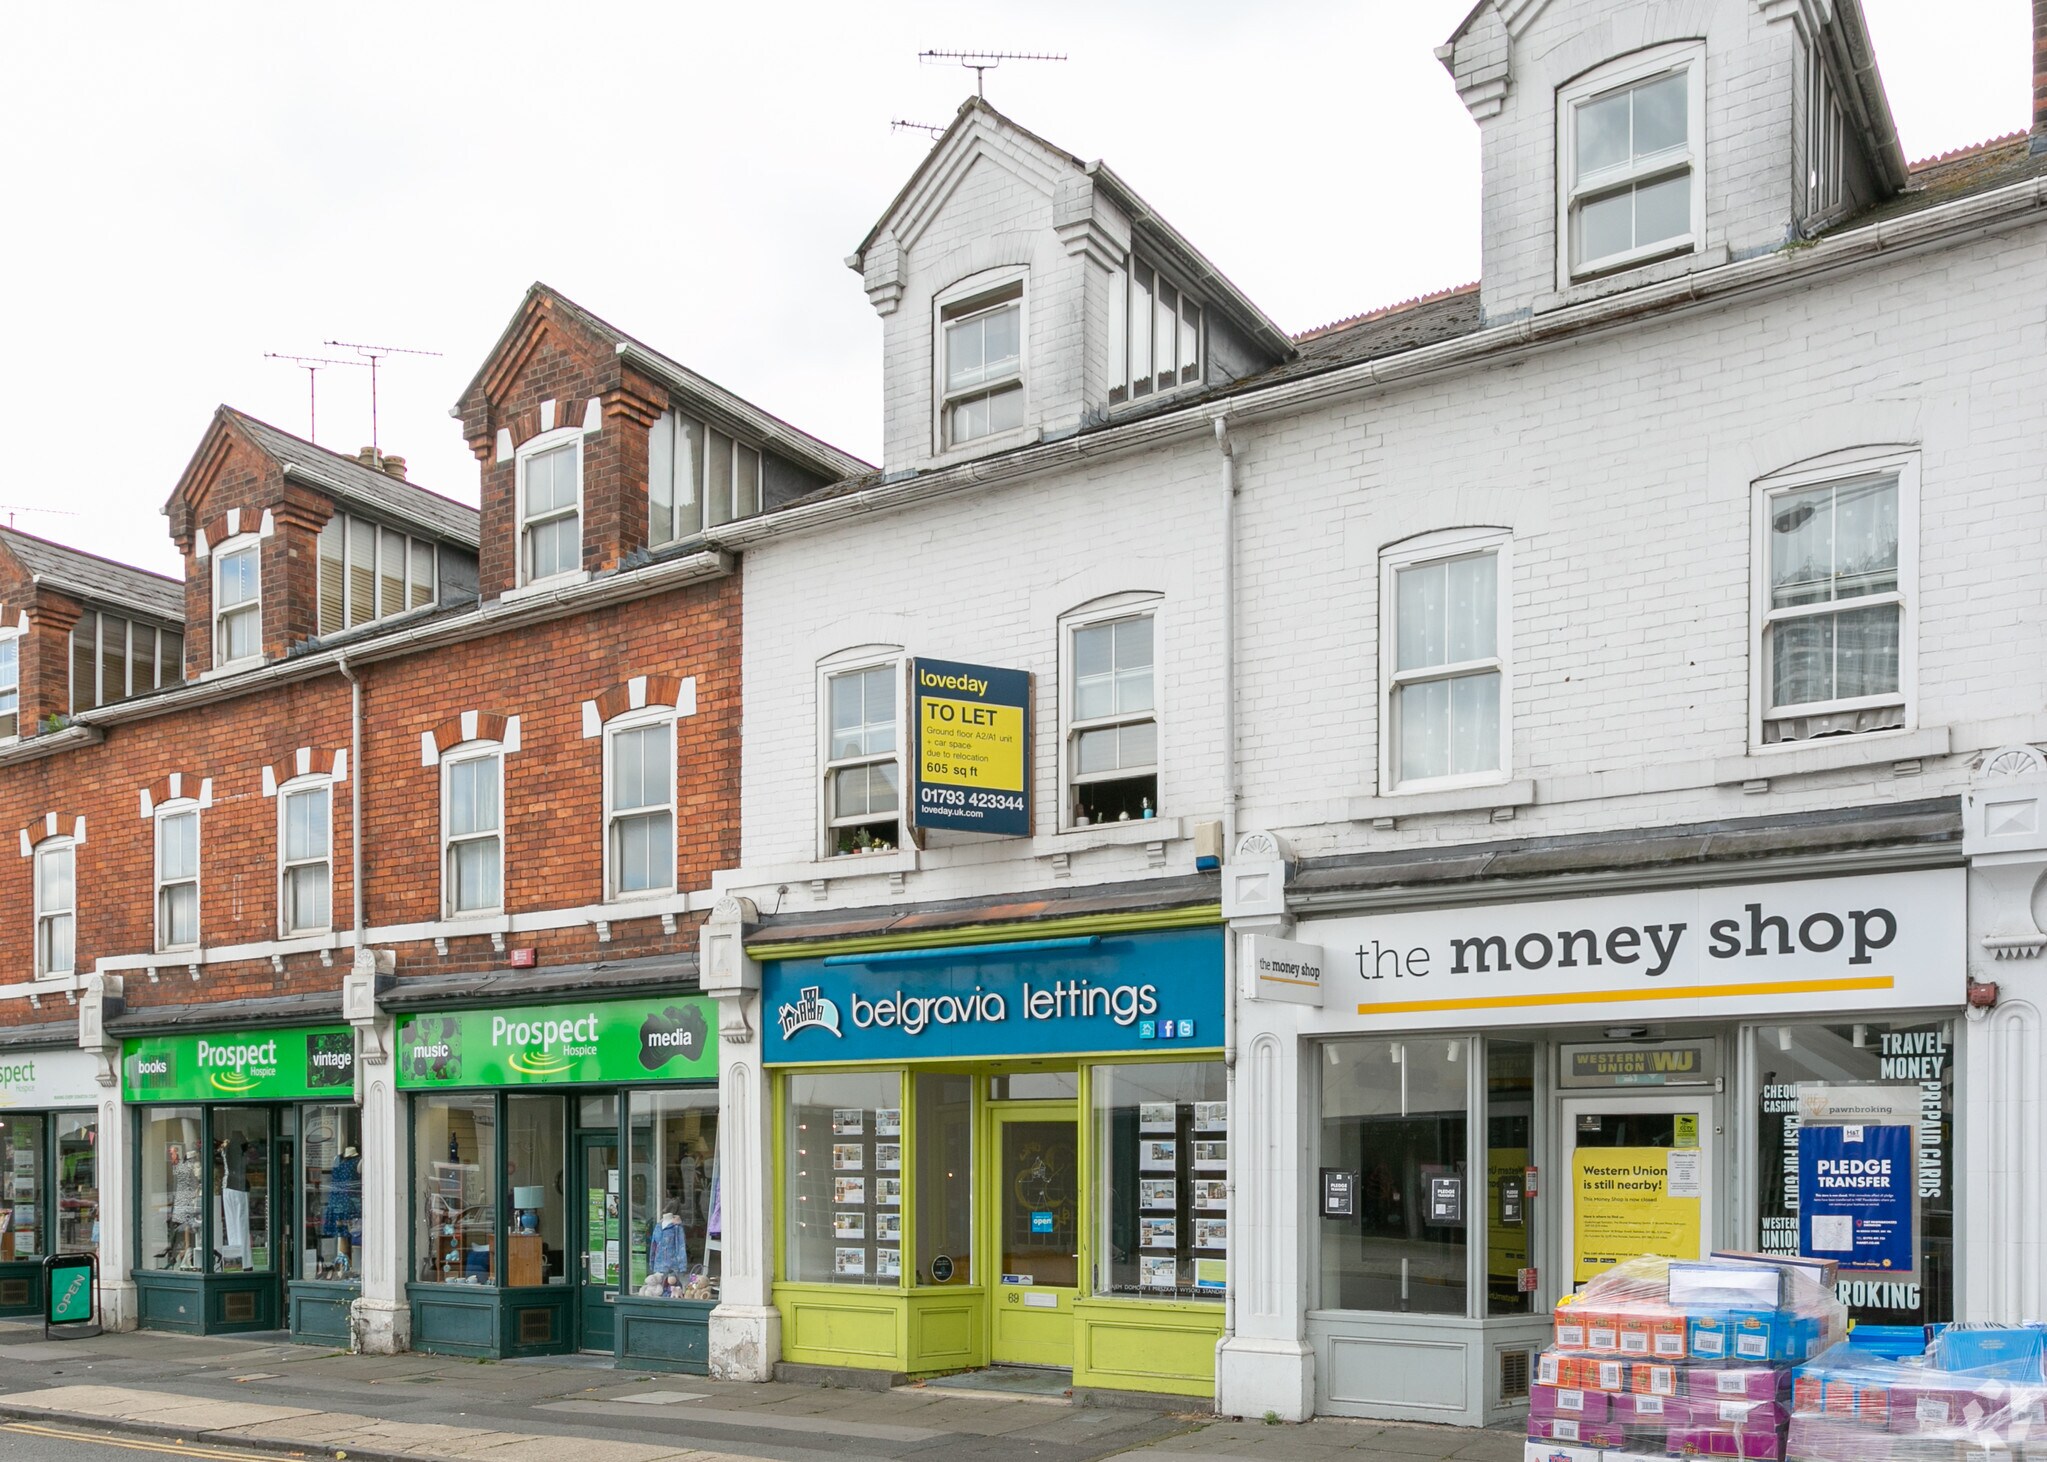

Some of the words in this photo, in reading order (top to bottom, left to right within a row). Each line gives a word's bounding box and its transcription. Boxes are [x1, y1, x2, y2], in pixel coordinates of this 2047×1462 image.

[920, 668, 988, 697] loveday
[926, 702, 955, 722] TO
[961, 706, 998, 726] LET
[926, 726, 955, 737] Ground
[956, 729, 973, 739] floor
[975, 731, 997, 741] A2/A1
[999, 734, 1013, 743] unit
[934, 738, 947, 747] car
[948, 740, 972, 750] space
[926, 749, 941, 758] due
[943, 750, 951, 759] to
[952, 752, 989, 763] relocation
[926, 761, 949, 774] 605
[953, 766, 967, 778] sq
[969, 765, 978, 777] ft
[921, 787, 966, 806] 01793
[968, 792, 1025, 811] 423344
[921, 804, 984, 819] loveday.uk.com
[1355, 940, 1431, 980] the
[1450, 922, 1688, 977] money
[1708, 903, 1898, 965] shop
[1259, 957, 1271, 971] the
[1272, 960, 1300, 978] money
[1301, 962, 1320, 981] shop
[852, 986, 1006, 1036] belgravia
[1023, 979, 1158, 1026] lettings
[492, 1013, 599, 1053] Prospect
[648, 1028, 692, 1048] media
[413, 1041, 449, 1059] music
[562, 1044, 598, 1056] Hospice
[1880, 1032, 1947, 1055] TRAVEL
[197, 1039, 277, 1073] Prospect
[312, 1051, 352, 1070] vintage
[1576, 1052, 1645, 1064] WESTERN
[1652, 1050, 1694, 1071] WU
[138, 1060, 167, 1074] books
[250, 1066, 276, 1078] Hospice
[1597, 1061, 1645, 1073] UNION
[1880, 1056, 1944, 1080] MONEY
[1828, 1105, 1893, 1115] pawnbroking
[1918, 1081, 1942, 1145] PREPAID
[1783, 1115, 1801, 1146] CASH
[1583, 1165, 1630, 1176] Western
[1632, 1165, 1668, 1176] Union
[1817, 1159, 1892, 1175] PLEDGE
[1918, 1148, 1942, 1198] CARDS
[1583, 1179, 1592, 1190] is
[1594, 1179, 1615, 1190] still
[1617, 1179, 1662, 1192] nearby!
[1817, 1176, 1890, 1188] TRANSFER
[1033, 1218, 1052, 1226] open
[56, 1273, 86, 1314] OPEN
[1834, 1279, 1921, 1311] ROKING
